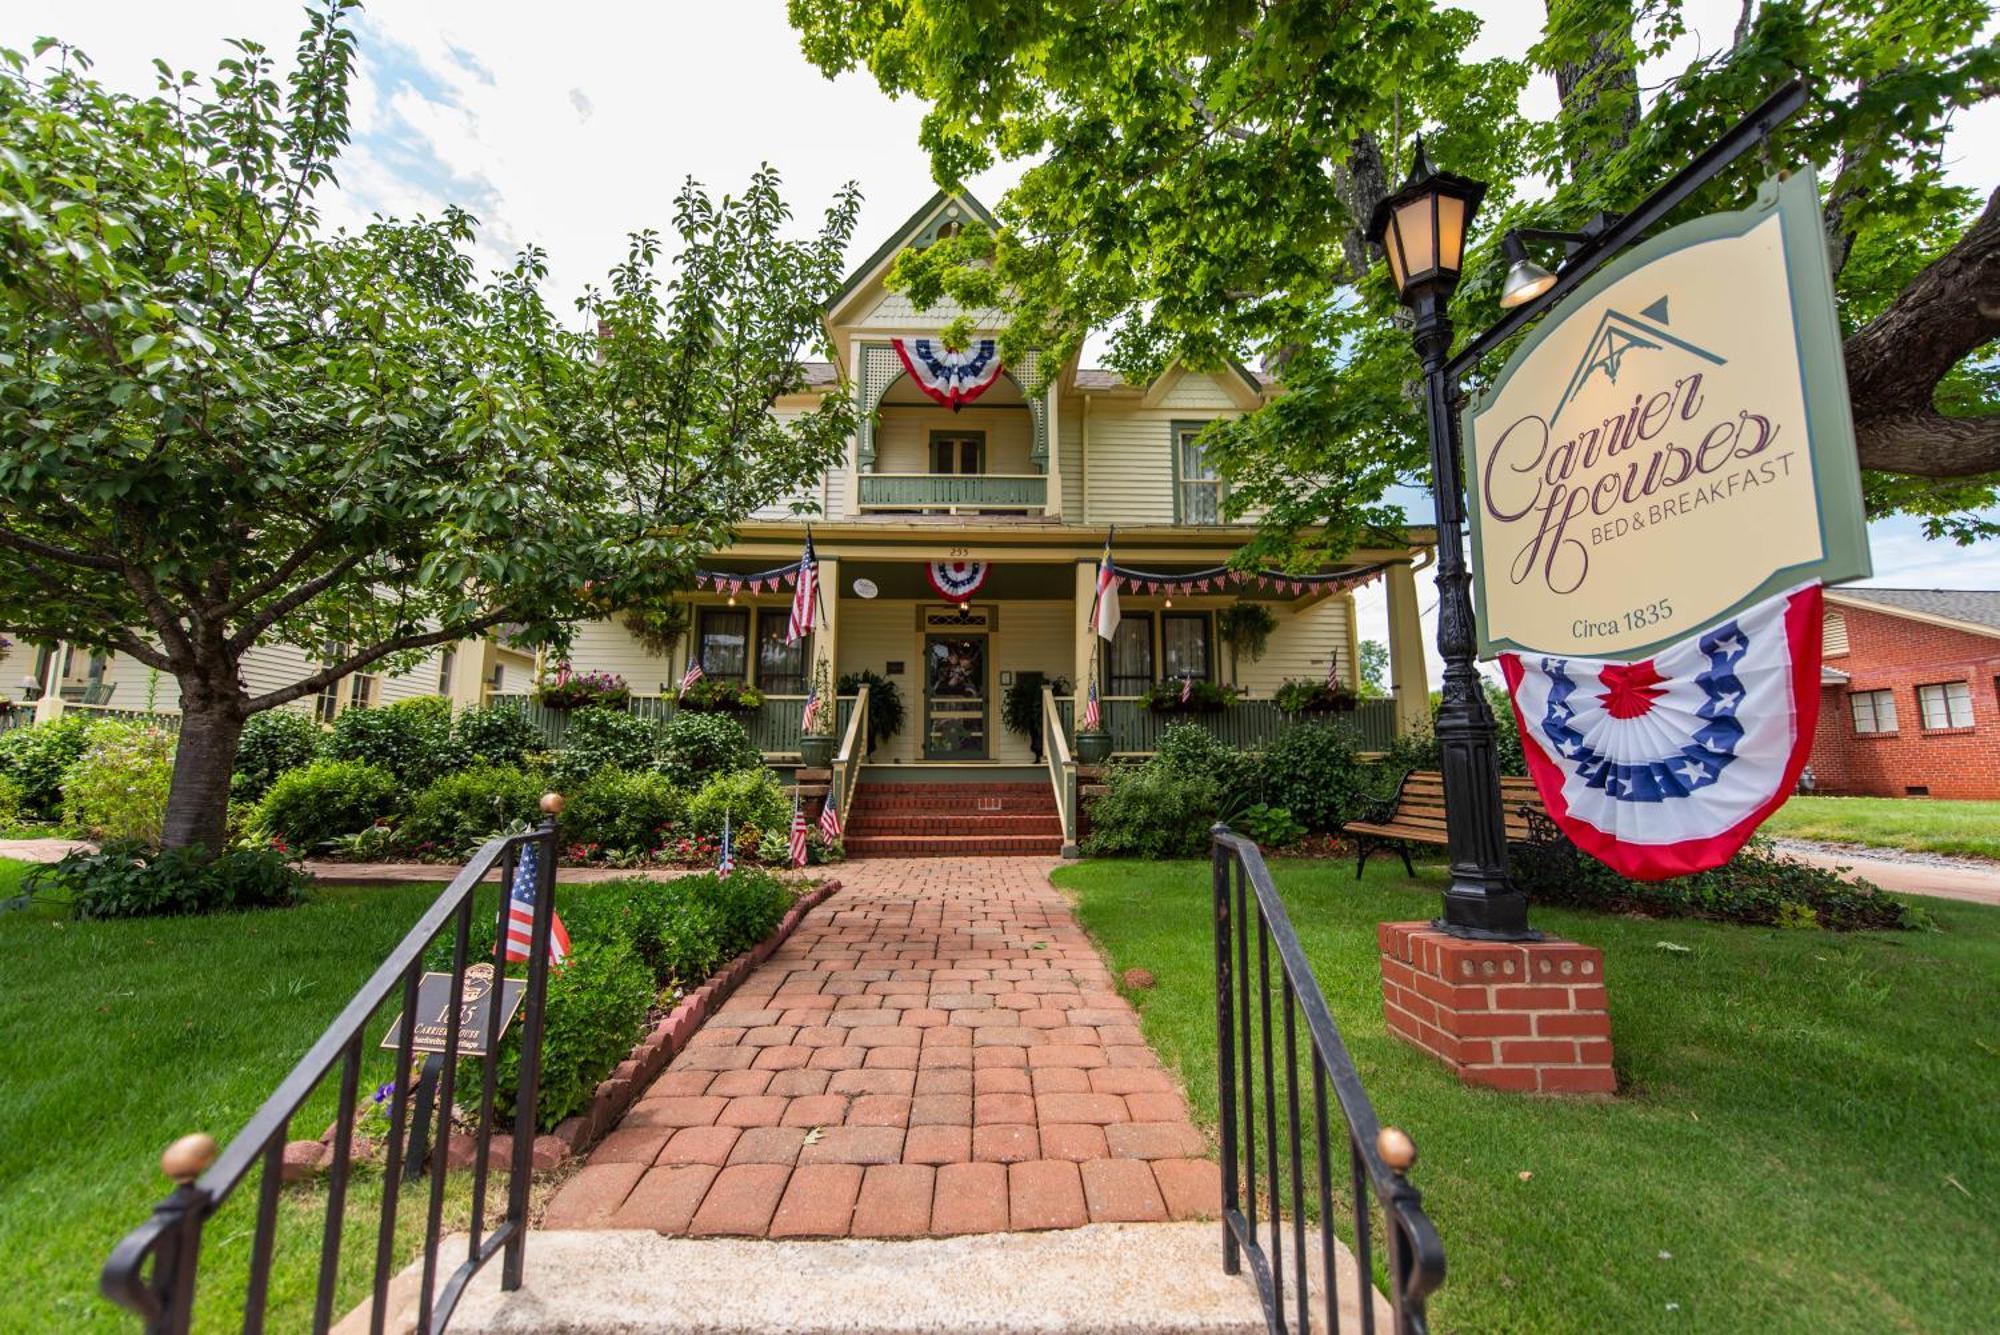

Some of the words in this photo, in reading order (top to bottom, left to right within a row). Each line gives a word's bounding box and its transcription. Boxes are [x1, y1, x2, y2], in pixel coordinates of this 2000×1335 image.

[1484, 373, 1705, 522] Carrier
[1510, 410, 1781, 594] Houses
[1572, 615, 1619, 640] Circa
[1624, 598, 1674, 631] 1835
